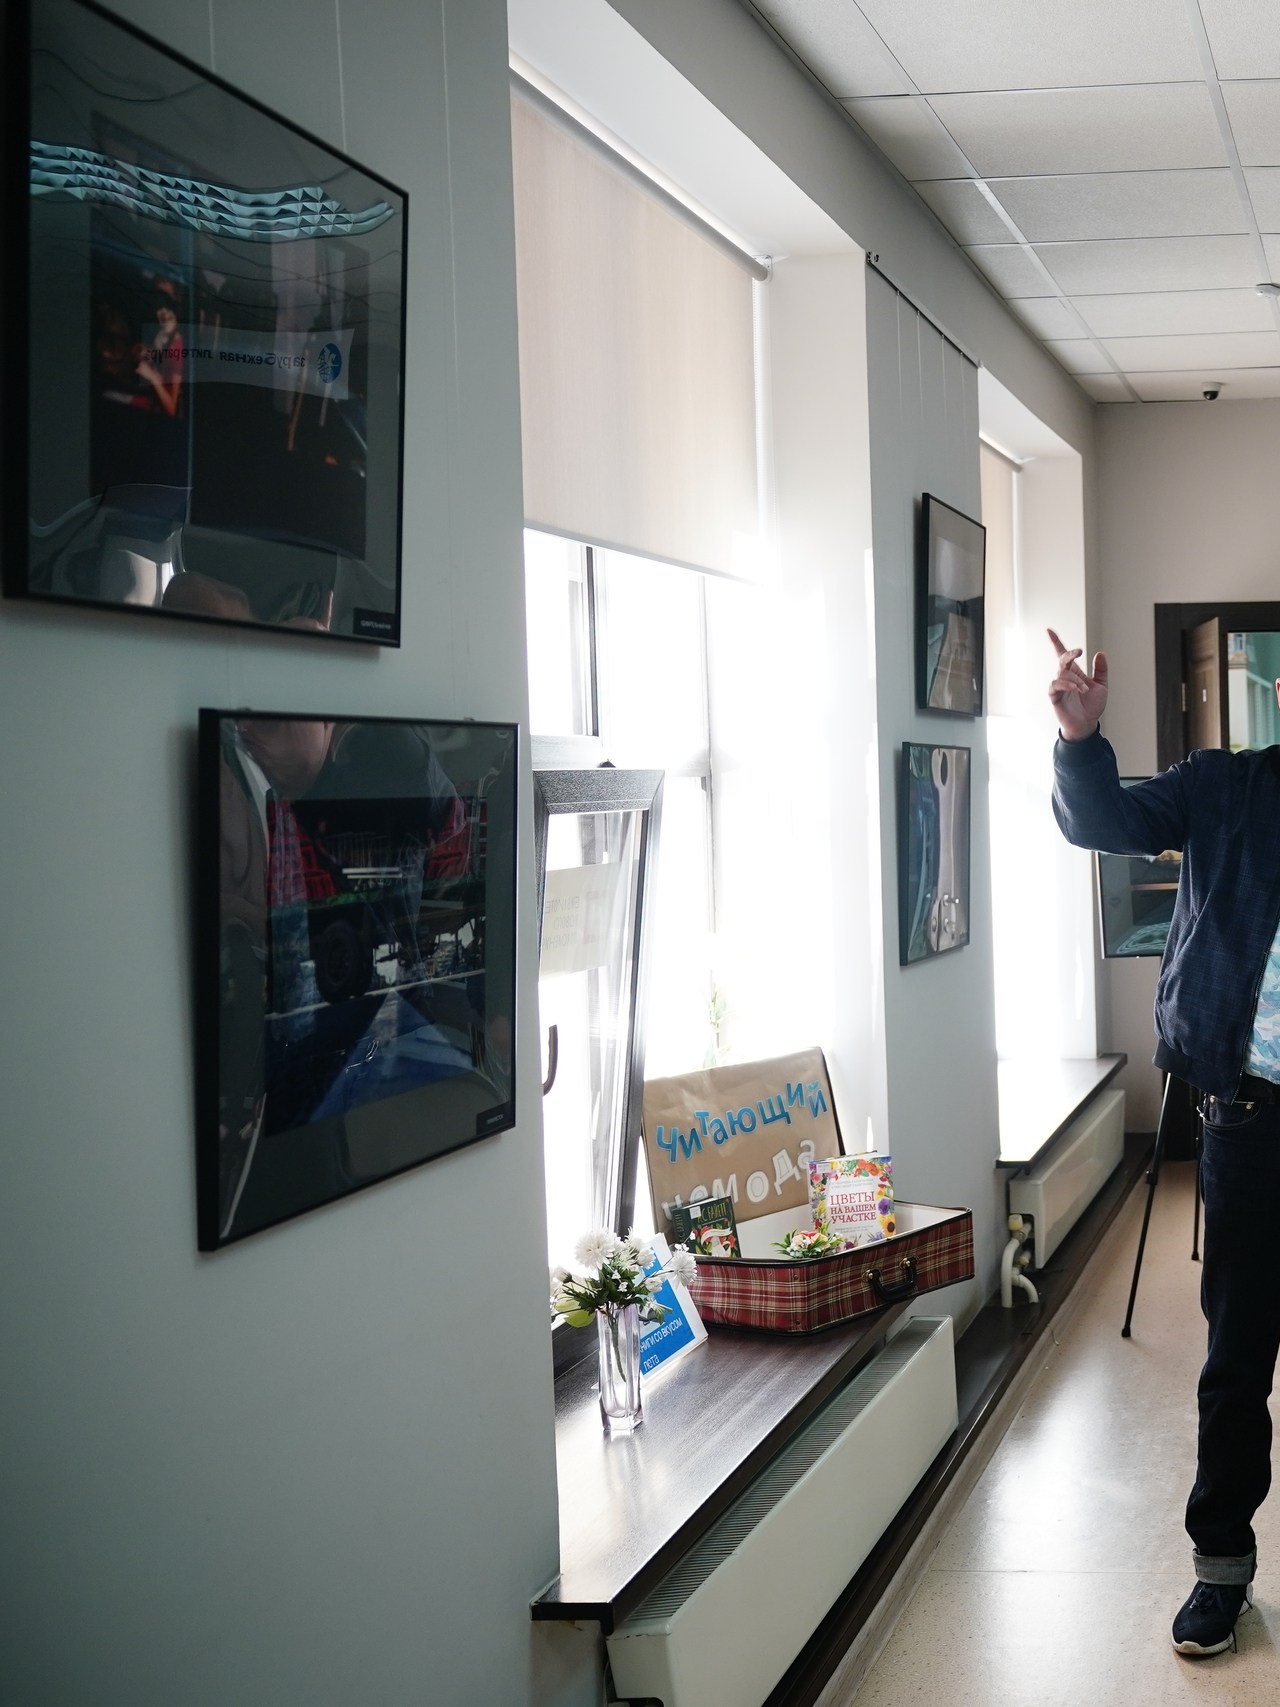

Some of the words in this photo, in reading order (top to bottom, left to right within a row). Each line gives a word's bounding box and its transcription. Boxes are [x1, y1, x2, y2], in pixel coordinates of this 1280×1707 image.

[830, 1192, 875, 1207] ЦВЕТЫ
[830, 1206, 843, 1214] НА
[844, 1204, 877, 1214] ВАШЕМ
[830, 1212, 877, 1224] УЧАСТКЕ
[662, 1318, 683, 1337] ВКУСОМ
